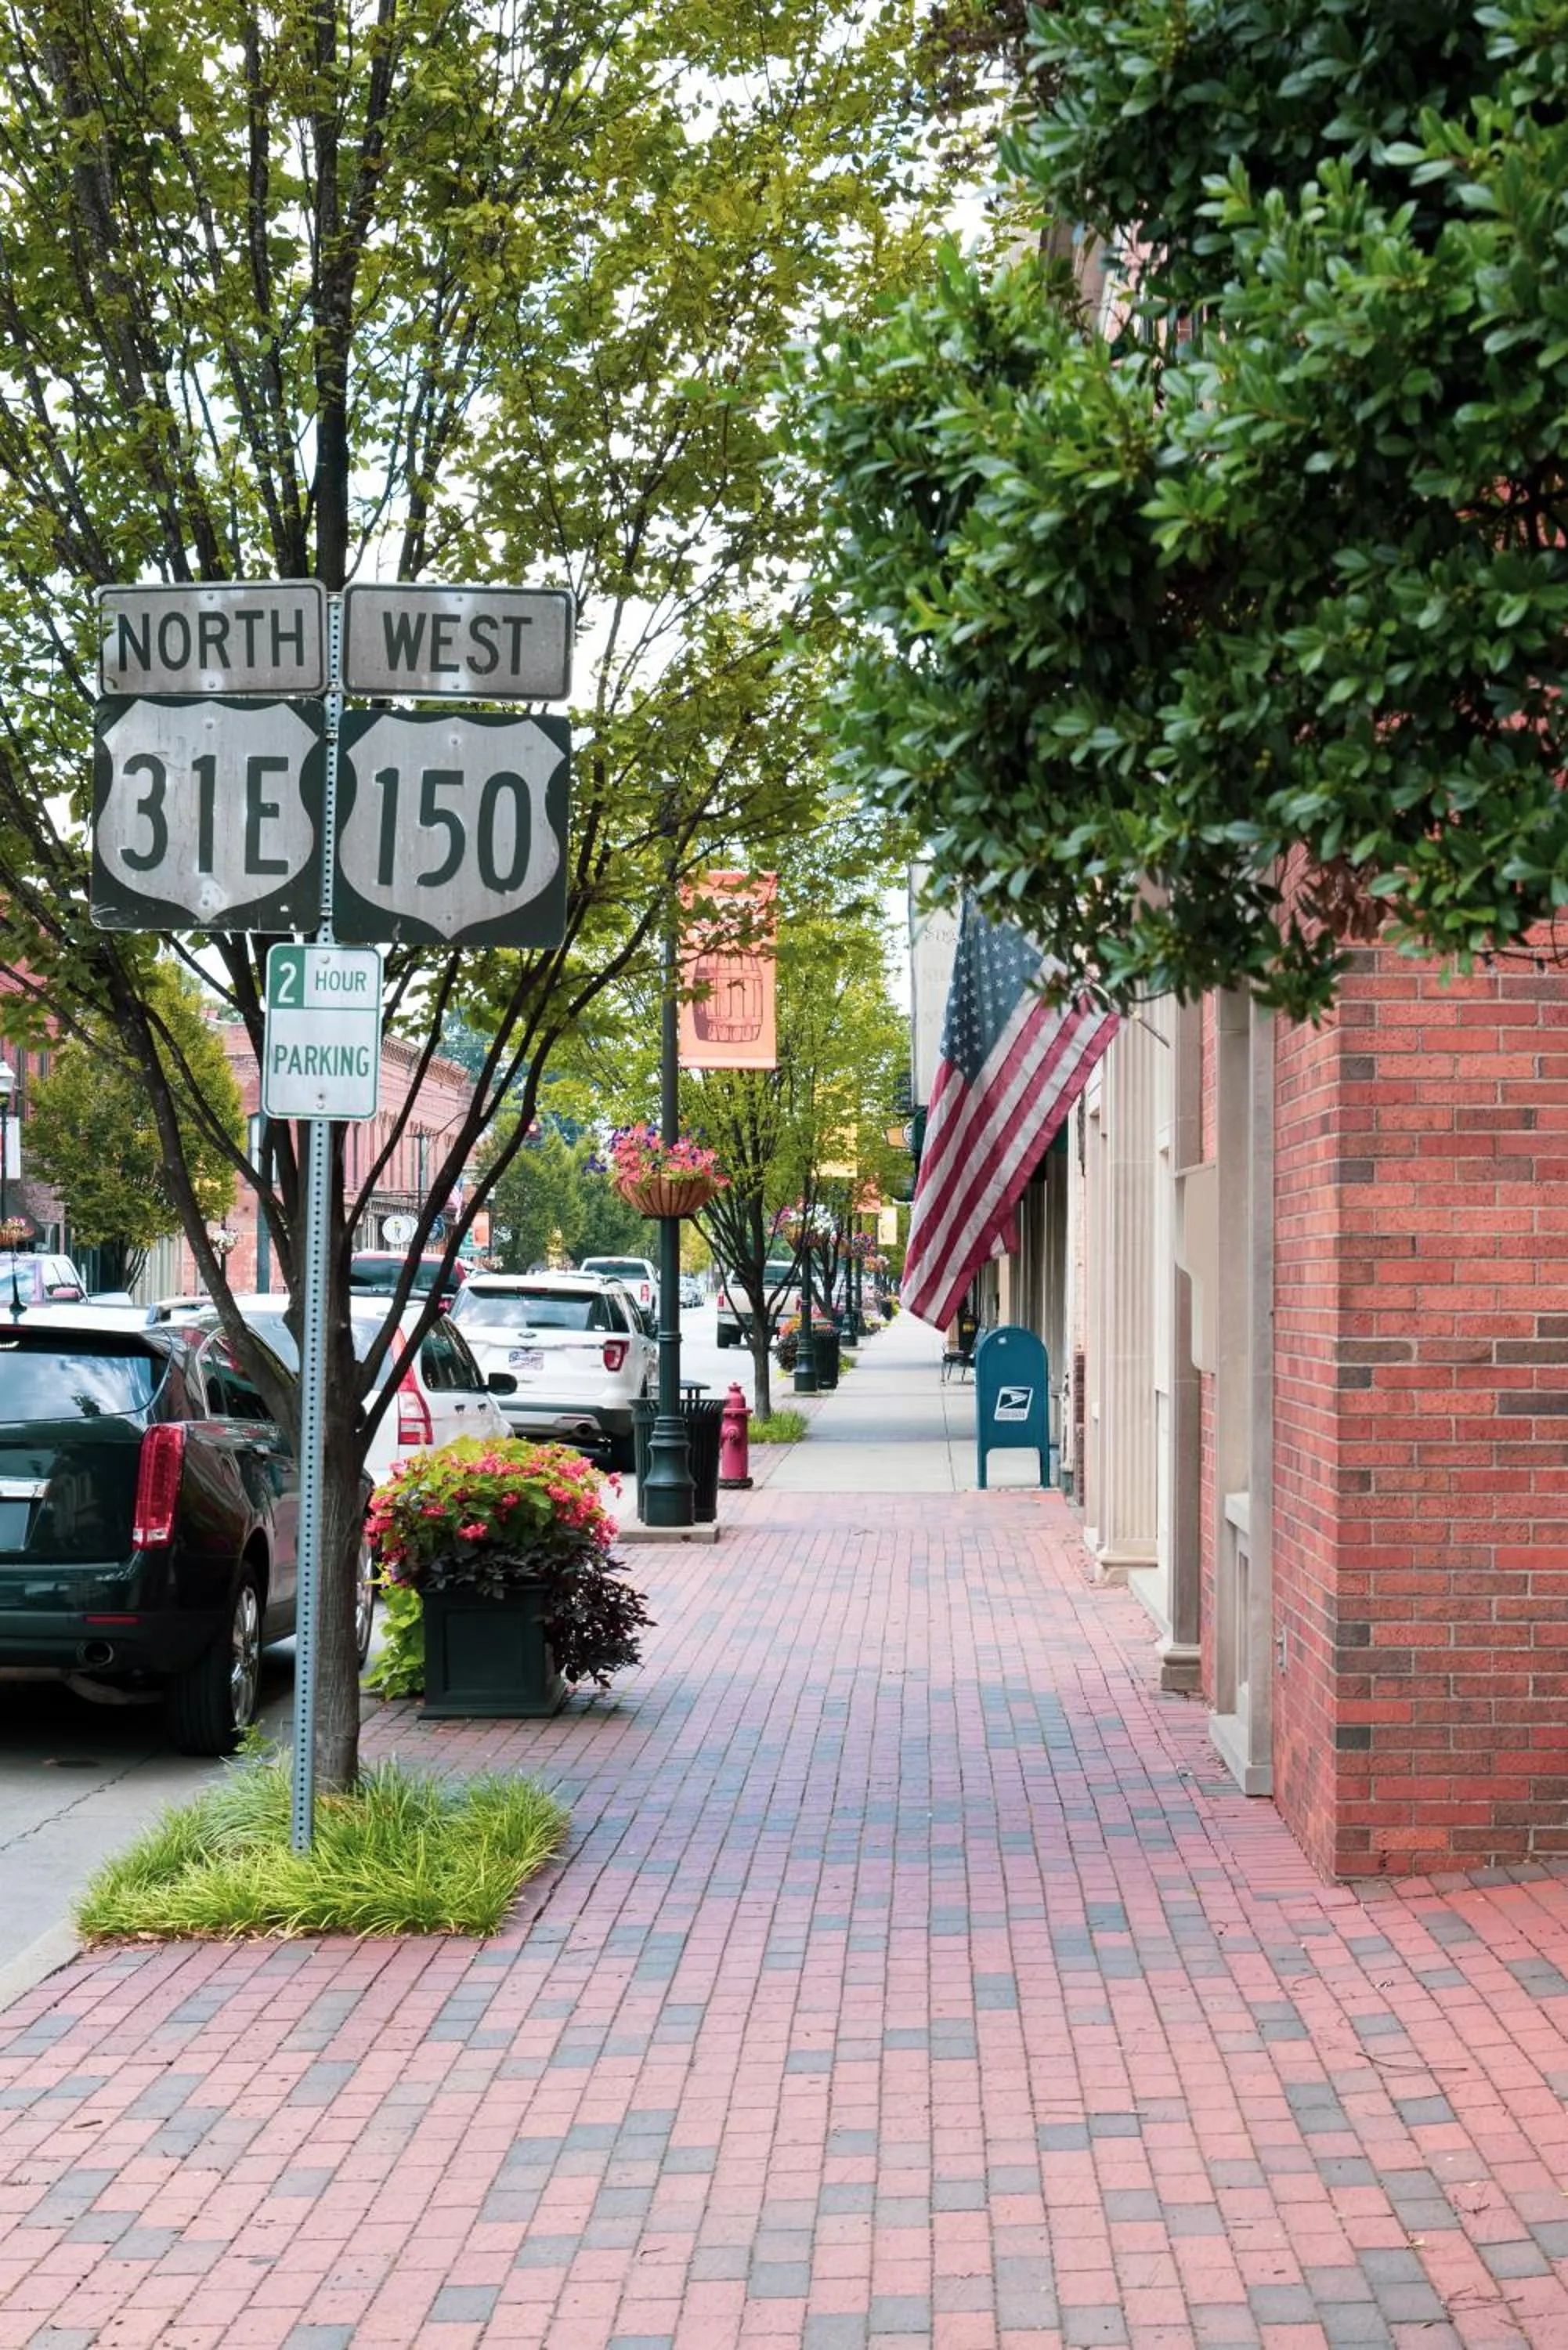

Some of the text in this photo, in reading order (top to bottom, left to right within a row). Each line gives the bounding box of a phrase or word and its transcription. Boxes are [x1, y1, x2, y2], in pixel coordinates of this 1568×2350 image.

[117, 609, 305, 673] NORTH
[383, 612, 533, 675] WEST
[120, 753, 289, 876] 31E
[375, 767, 532, 895] 150
[277, 962, 367, 1003] 2 HOUR
[274, 1044, 369, 1077] PARKING
